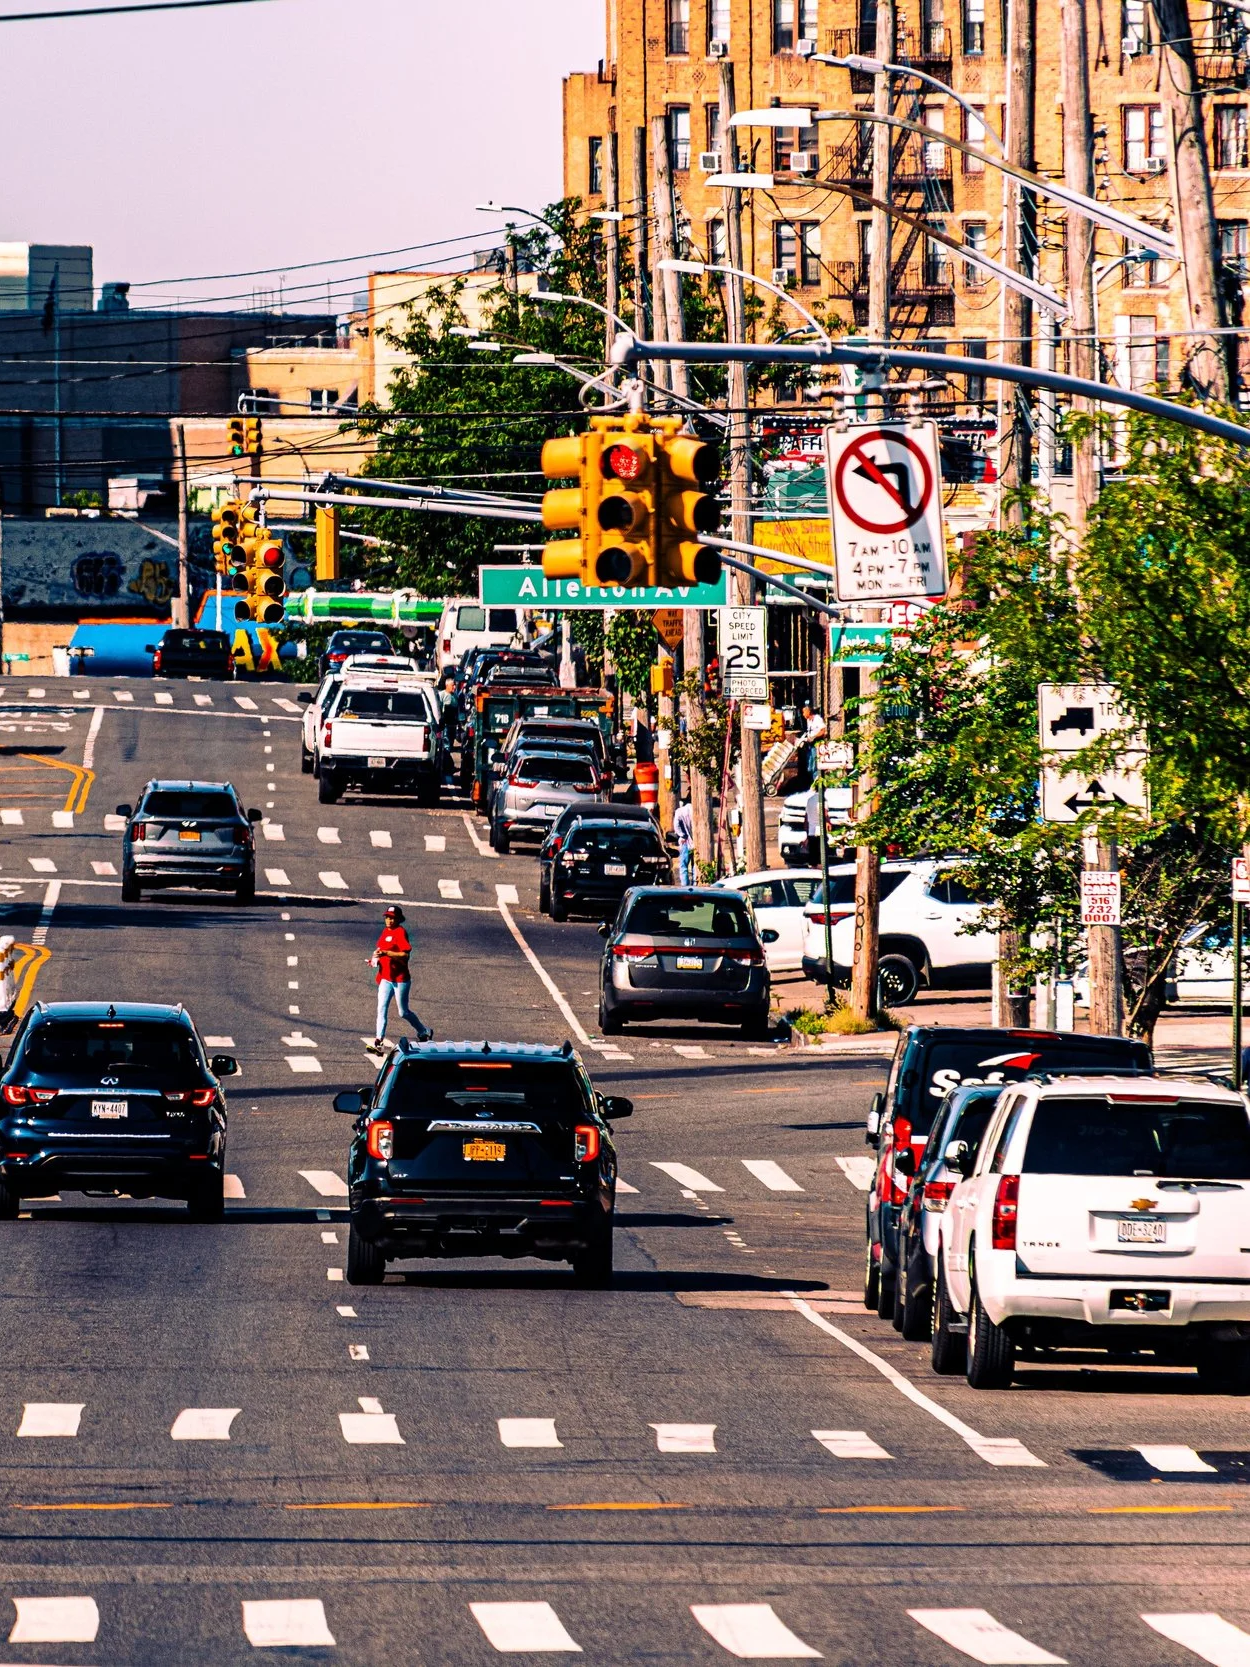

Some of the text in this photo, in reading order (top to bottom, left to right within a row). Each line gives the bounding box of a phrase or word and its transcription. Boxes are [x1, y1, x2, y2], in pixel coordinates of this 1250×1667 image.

[848, 542, 858, 557] 7
[861, 546, 879, 556] AM
[892, 539, 909, 554] 10
[913, 542, 931, 553] AM
[852, 562, 862, 576] 4
[868, 564, 885, 575] PM
[897, 558, 908, 573] 7
[913, 561, 930, 572] PM
[857, 580, 883, 590] MON
[909, 576, 927, 588] FRI
[732, 611, 751, 620] CITY
[728, 622, 756, 630] SPEED
[726, 644, 761, 669] 25
[724, 687, 764, 695] ENFORCED
[1086, 896, 1115, 905] (516)
[1088, 905, 1112, 914] 232
[1084, 914, 1117, 923] 0007
[93, 1103, 126, 1114] KYN-4407
